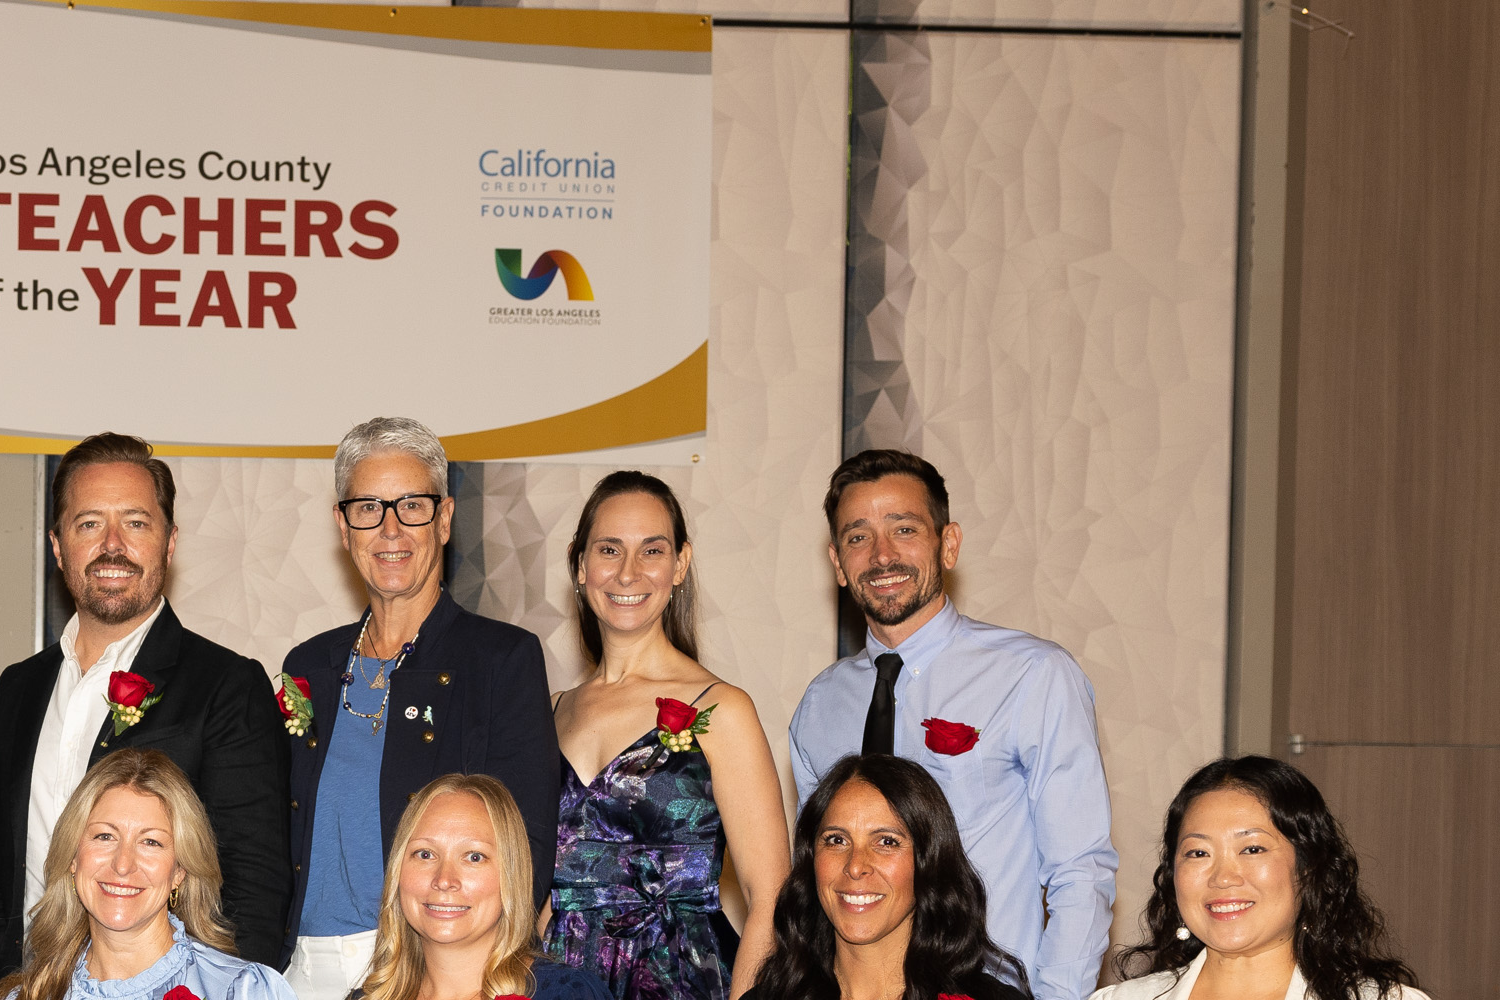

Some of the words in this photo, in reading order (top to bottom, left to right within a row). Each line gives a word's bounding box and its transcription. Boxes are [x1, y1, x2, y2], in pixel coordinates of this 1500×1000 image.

[37, 147, 186, 186] Angeles
[198, 150, 332, 191] County
[478, 149, 616, 179] California
[480, 181, 547, 193] CREDIT
[559, 183, 615, 194] UNION
[481, 204, 613, 220] FOUNDATION
[13, 279, 80, 312] the
[81, 267, 298, 330] YEAR
[489, 307, 533, 316] GREATER
[535, 308, 554, 317] LOS
[556, 309, 600, 318] ANGELES
[488, 316, 540, 325] EDUCATION
[542, 317, 601, 326] FOUNDATION
